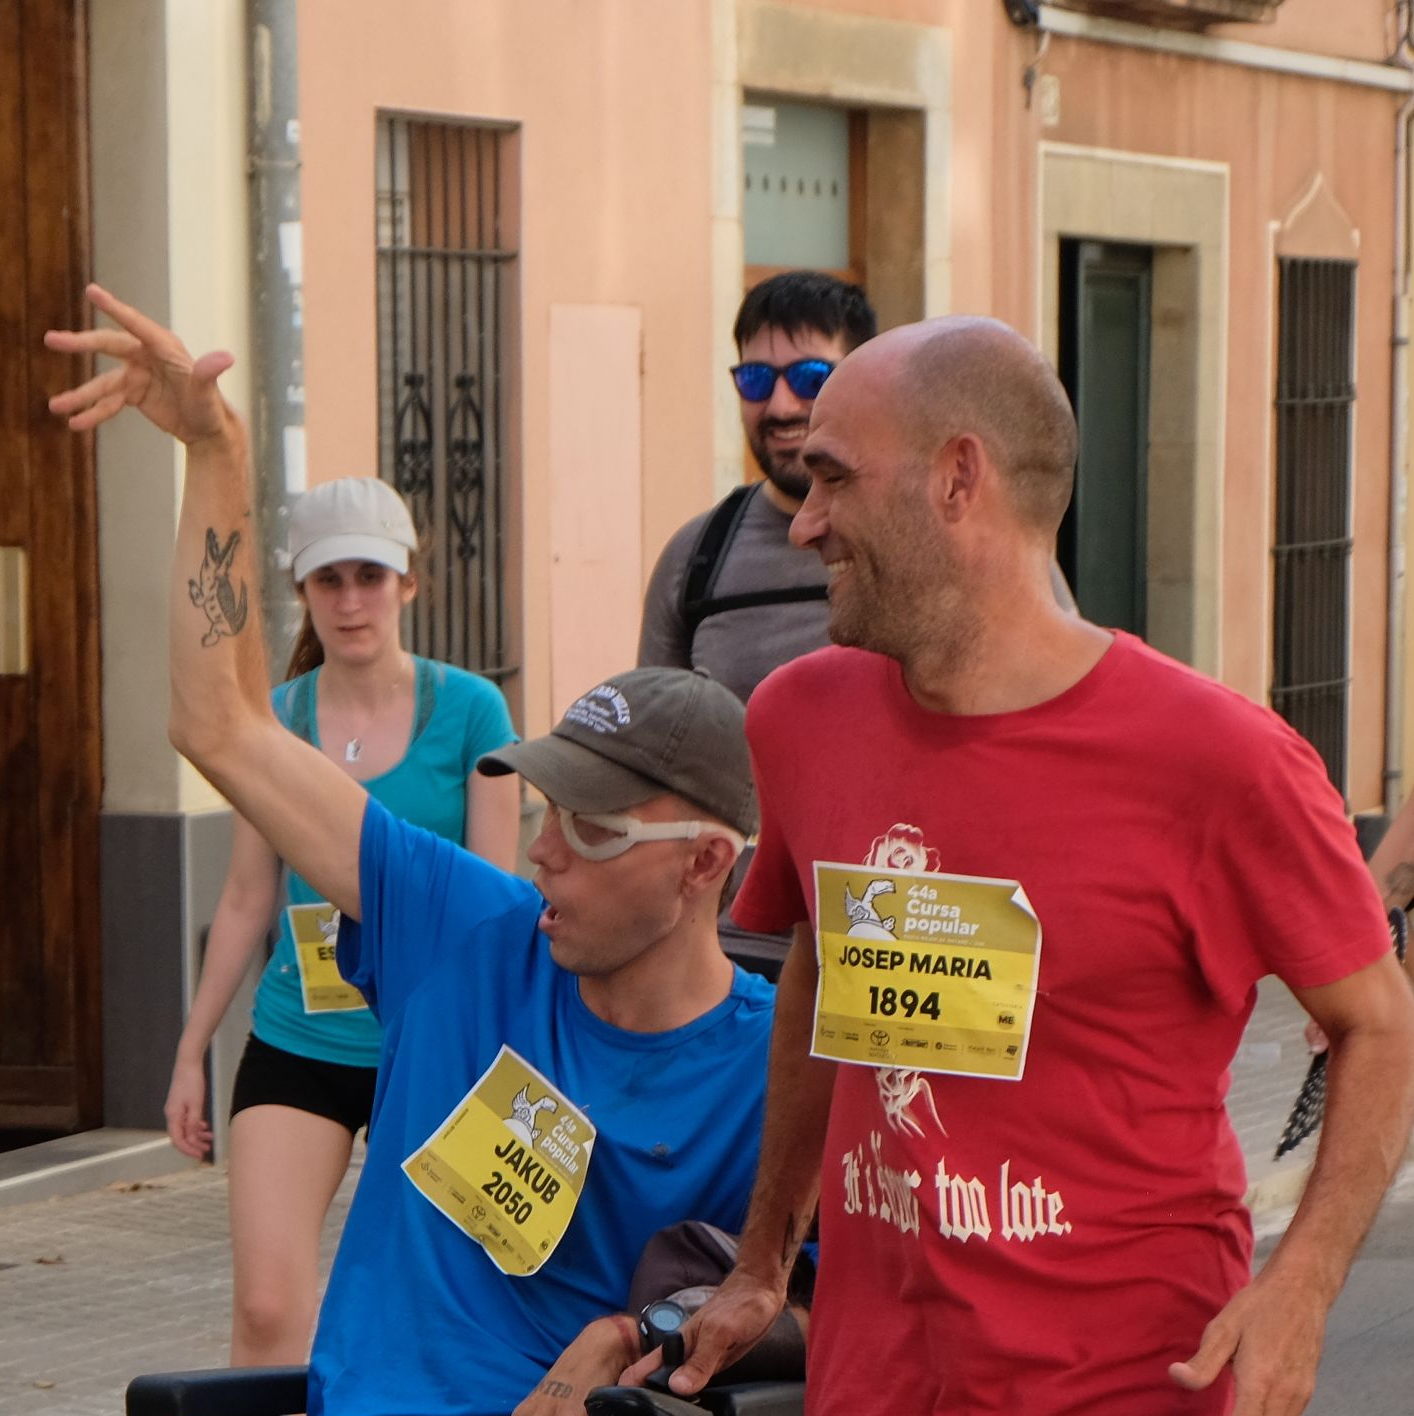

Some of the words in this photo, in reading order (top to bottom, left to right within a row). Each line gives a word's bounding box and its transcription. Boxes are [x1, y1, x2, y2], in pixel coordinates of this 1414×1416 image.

[906, 899, 961, 919] Cursa
[907, 884, 938, 901] 44a
[903, 916, 980, 936] popular
[838, 945, 905, 973] JOSEP
[909, 952, 992, 981] MARIA
[868, 986, 941, 1021] 1894
[495, 1139, 561, 1205] JAKUB
[481, 1171, 533, 1225] 2050
[935, 1156, 992, 1244] too
[1000, 1158, 1073, 1243] late.
